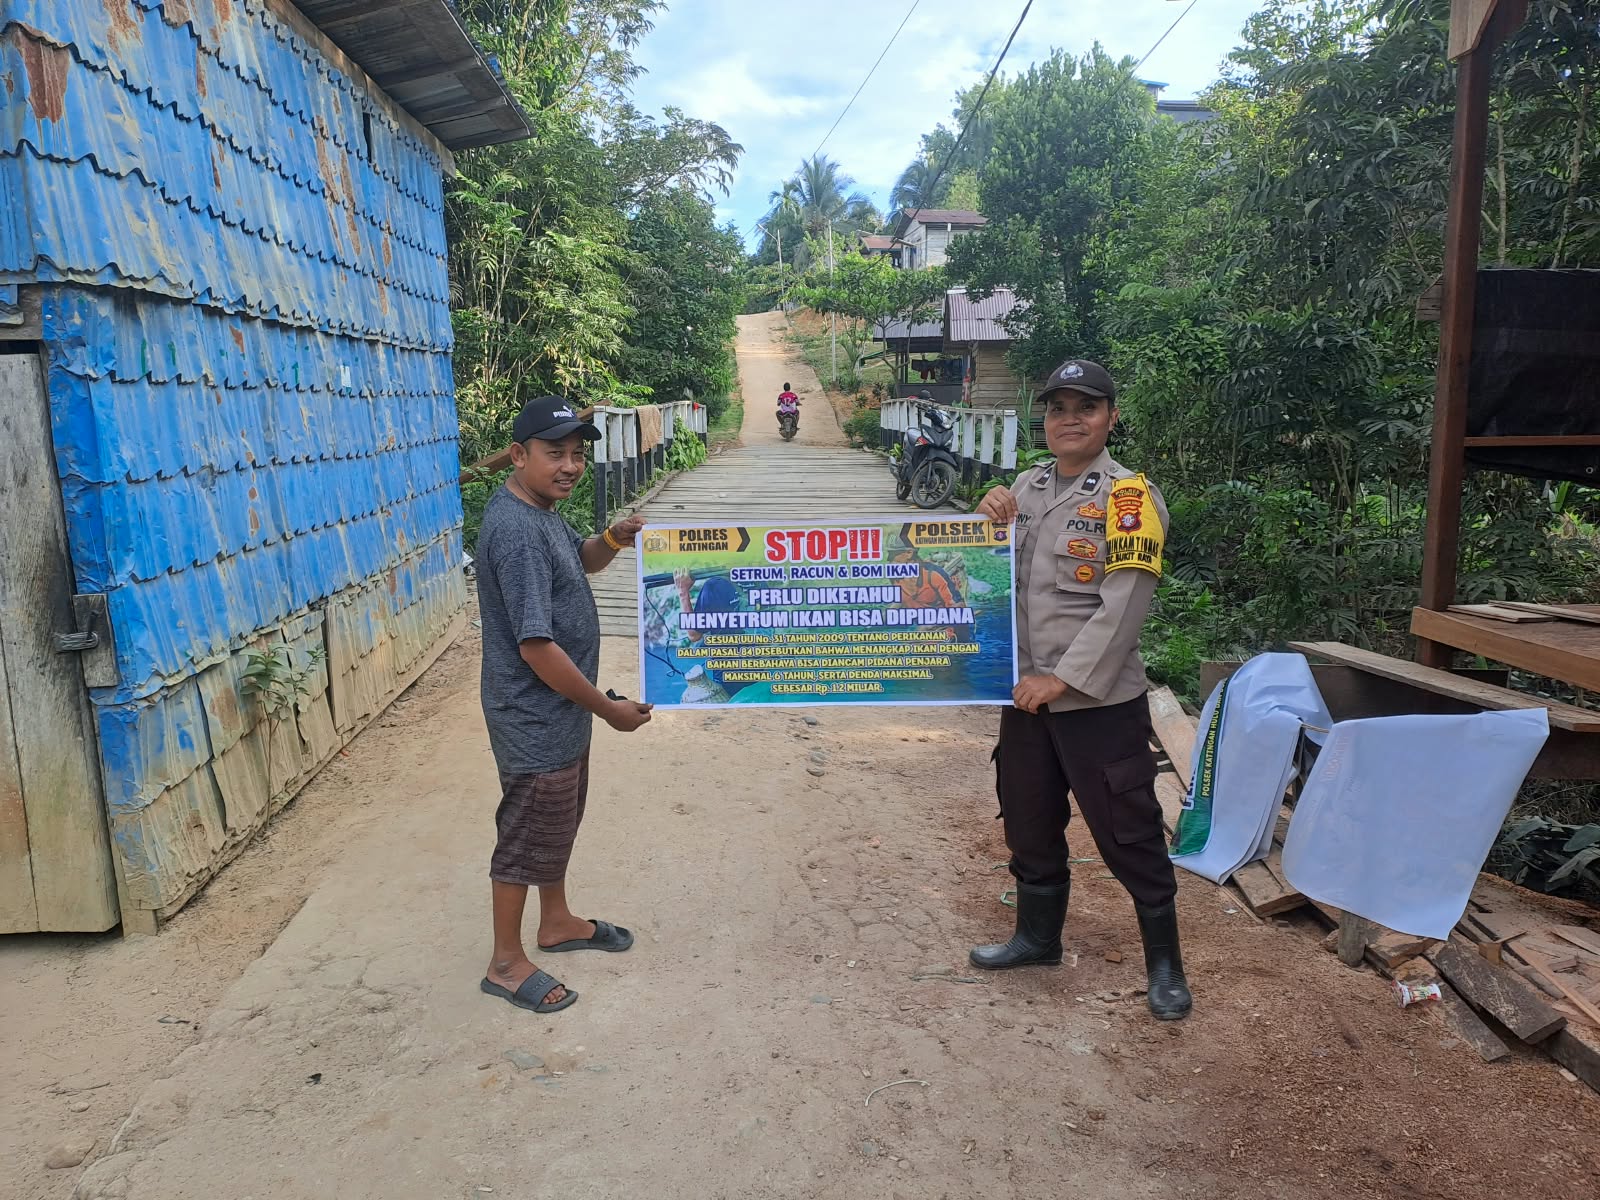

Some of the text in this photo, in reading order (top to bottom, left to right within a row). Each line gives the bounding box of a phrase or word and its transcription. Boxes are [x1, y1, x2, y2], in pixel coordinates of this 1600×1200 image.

[679, 529, 728, 541] POLRES
[915, 522, 985, 537] POLSEK
[679, 542, 729, 552] KATINGAN
[766, 529, 881, 562] STOP!!!
[731, 564, 918, 581] SETRUM, RACUN & BOM IKAN
[749, 586, 902, 606] PERLU DIKETAHUI
[680, 607, 975, 629] MENYETRUM IKAN BISA DIPIDANA
[705, 635, 739, 644] SESUAI
[741, 635, 755, 643] UU
[756, 635, 772, 643] No.
[774, 634, 784, 642] 31
[786, 634, 816, 642] TAHUN
[818, 634, 845, 642] 2009
[847, 633, 889, 641] TENTANG
[677, 644, 979, 657] DALAM PASAL 84 DISEBUTKAN BAHWA MENANGKAP IKAN DENGAN
[707, 657, 949, 669] BAHAN BERBAHAYA BISA DIANCAM PIDANA PENJARA
[724, 672, 771, 680] MAKSIMAL
[774, 672, 781, 680] 6
[783, 671, 816, 681] TAHUN,
[818, 671, 847, 679] SERTA
[849, 670, 881, 679] DENDA
[772, 684, 813, 693] SEBESAR
[815, 684, 830, 694] Rp.
[847, 683, 883, 692] MILIAR.
[1210, 710, 1219, 729] HULU
[1205, 730, 1215, 767] KATINGAN
[1202, 768, 1212, 796] POLSEK
